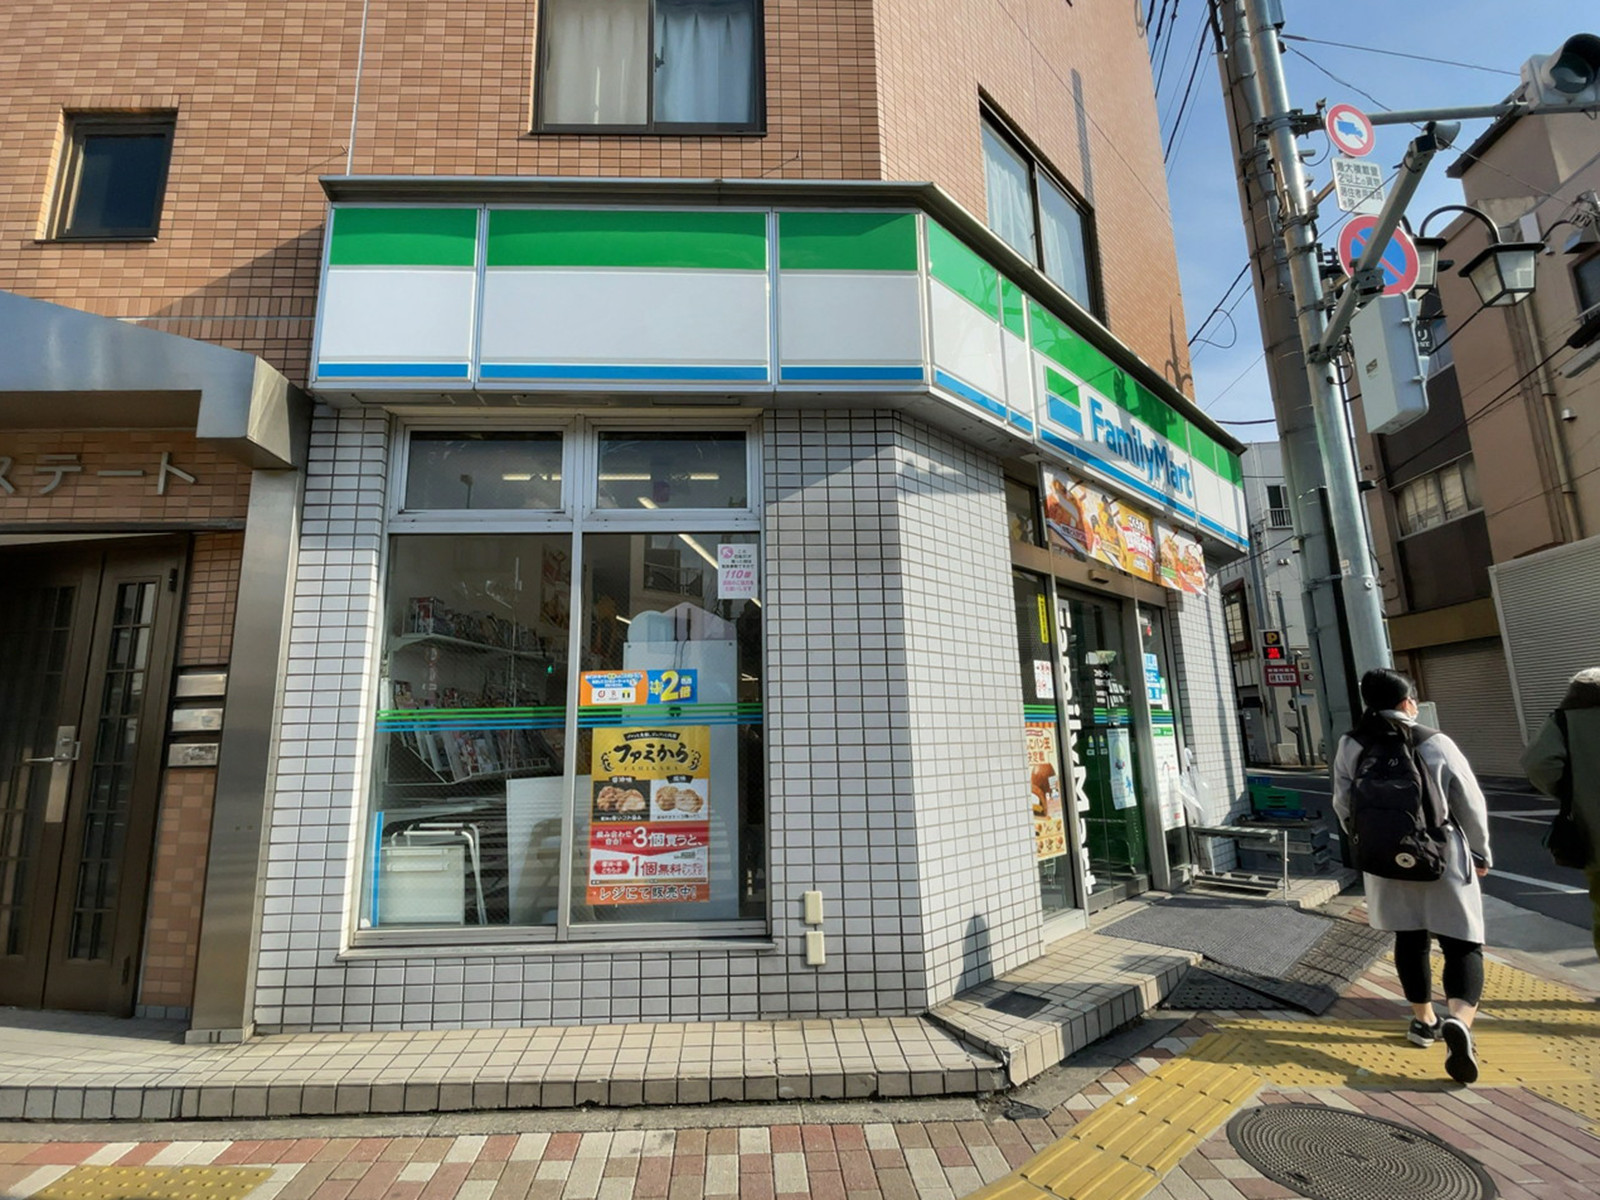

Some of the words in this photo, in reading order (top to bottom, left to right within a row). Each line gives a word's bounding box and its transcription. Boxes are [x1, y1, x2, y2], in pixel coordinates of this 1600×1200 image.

[1089, 396, 1193, 499] FamilyMart
[1266, 632, 1278, 644] P
[614, 742, 689, 763] ファミから
[632, 826, 703, 848] 3個買うと、
[632, 856, 682, 877] 1個無料
[600, 884, 697, 901] レジにて販売中!
